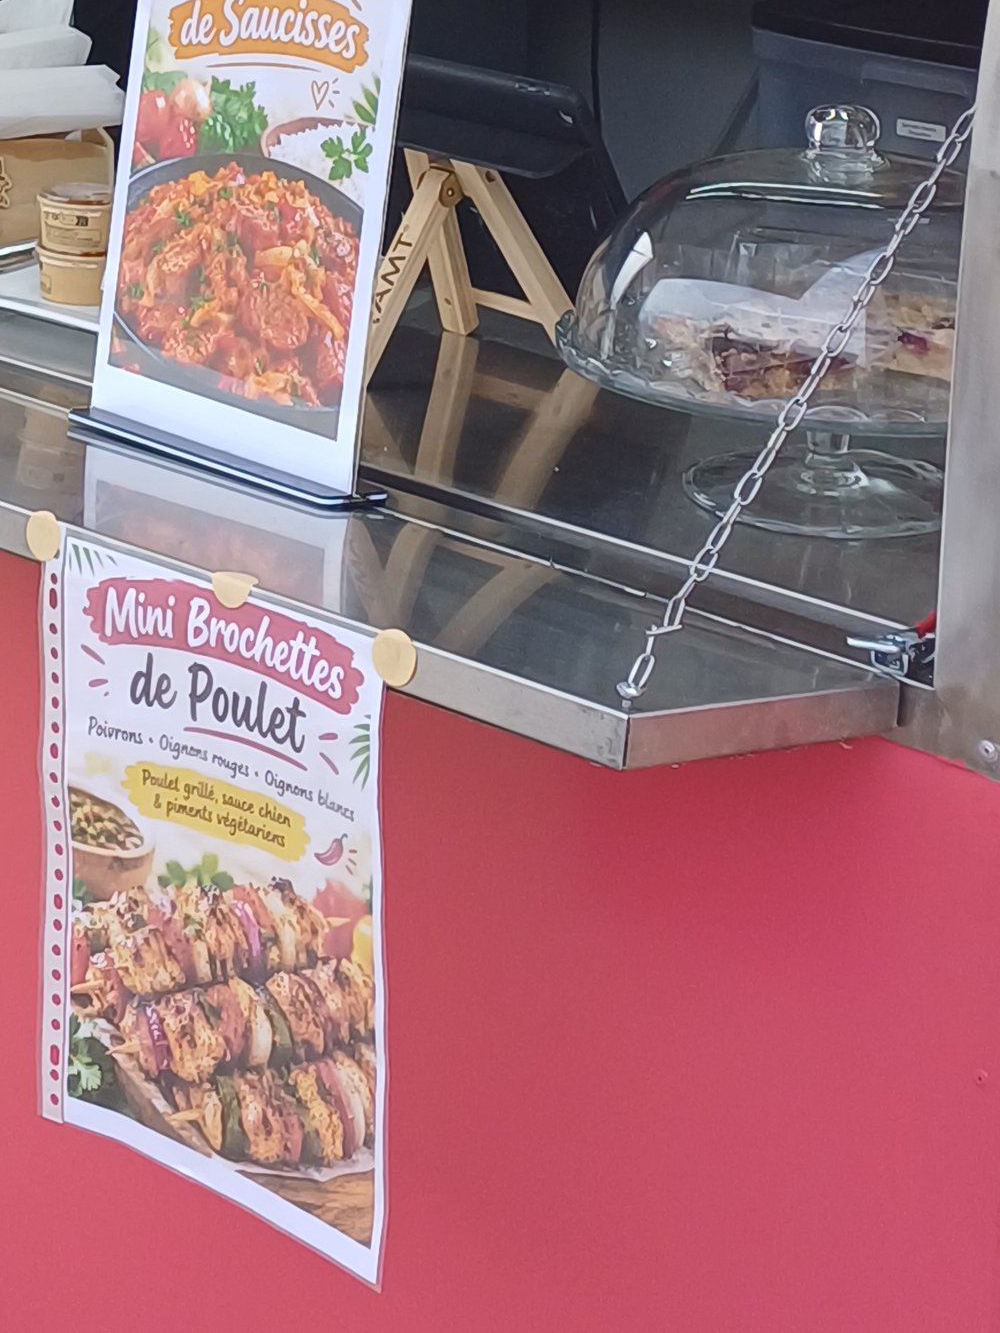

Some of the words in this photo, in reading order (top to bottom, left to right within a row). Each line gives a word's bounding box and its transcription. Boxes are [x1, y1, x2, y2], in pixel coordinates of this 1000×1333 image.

[180, 0, 216, 48] de
[373, 232, 412, 324] AMT
[104, 586, 176, 639] Mini
[187, 597, 345, 701] Brochettes
[130, 652, 178, 709] de
[188, 662, 307, 754] Poulet
[87, 715, 143, 746] Poivrons
[159, 734, 208, 762] Oignons
[211, 751, 250, 779] rouges
[264, 769, 314, 802] Oignons
[317, 785, 355, 823] blancs
[141, 768, 180, 795] Poulet
[221, 793, 255, 816] sauce
[258, 800, 292, 828] chien
[165, 798, 213, 824] piments
[216, 808, 287, 848] végétariens
